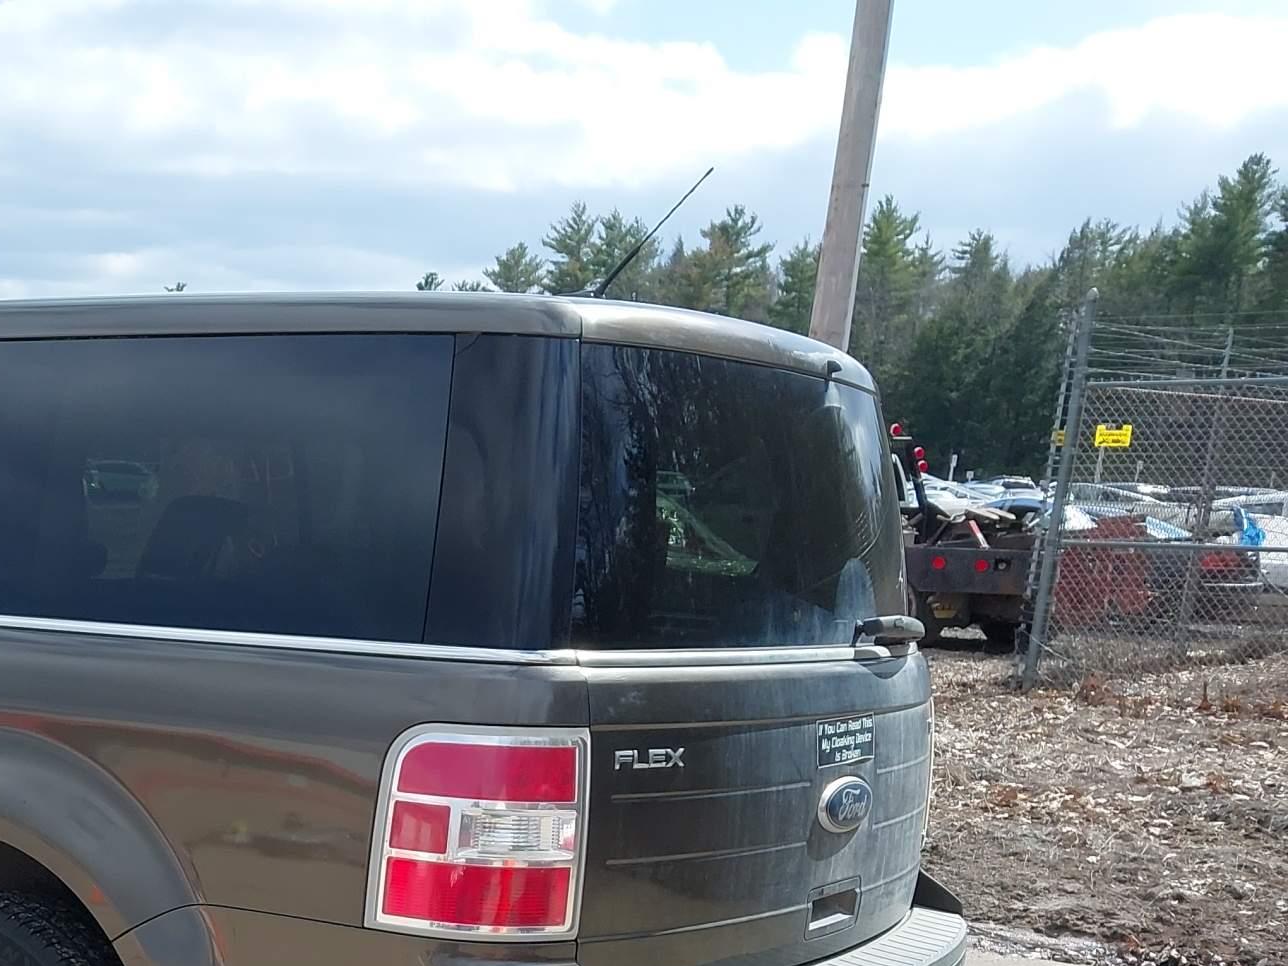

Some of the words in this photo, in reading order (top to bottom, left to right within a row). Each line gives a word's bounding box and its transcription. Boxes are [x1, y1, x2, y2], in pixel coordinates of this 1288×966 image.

[824, 724, 835, 735] You
[836, 721, 847, 733] Can
[848, 718, 861, 731] Read
[862, 717, 873, 729] This
[821, 738, 830, 753] My
[831, 734, 855, 752] Cloaking
[855, 731, 872, 744] Device
[614, 747, 686, 770] FLEX
[835, 751, 841, 762] Is
[841, 749, 861, 761] Broken
[838, 789, 867, 820] Ford
